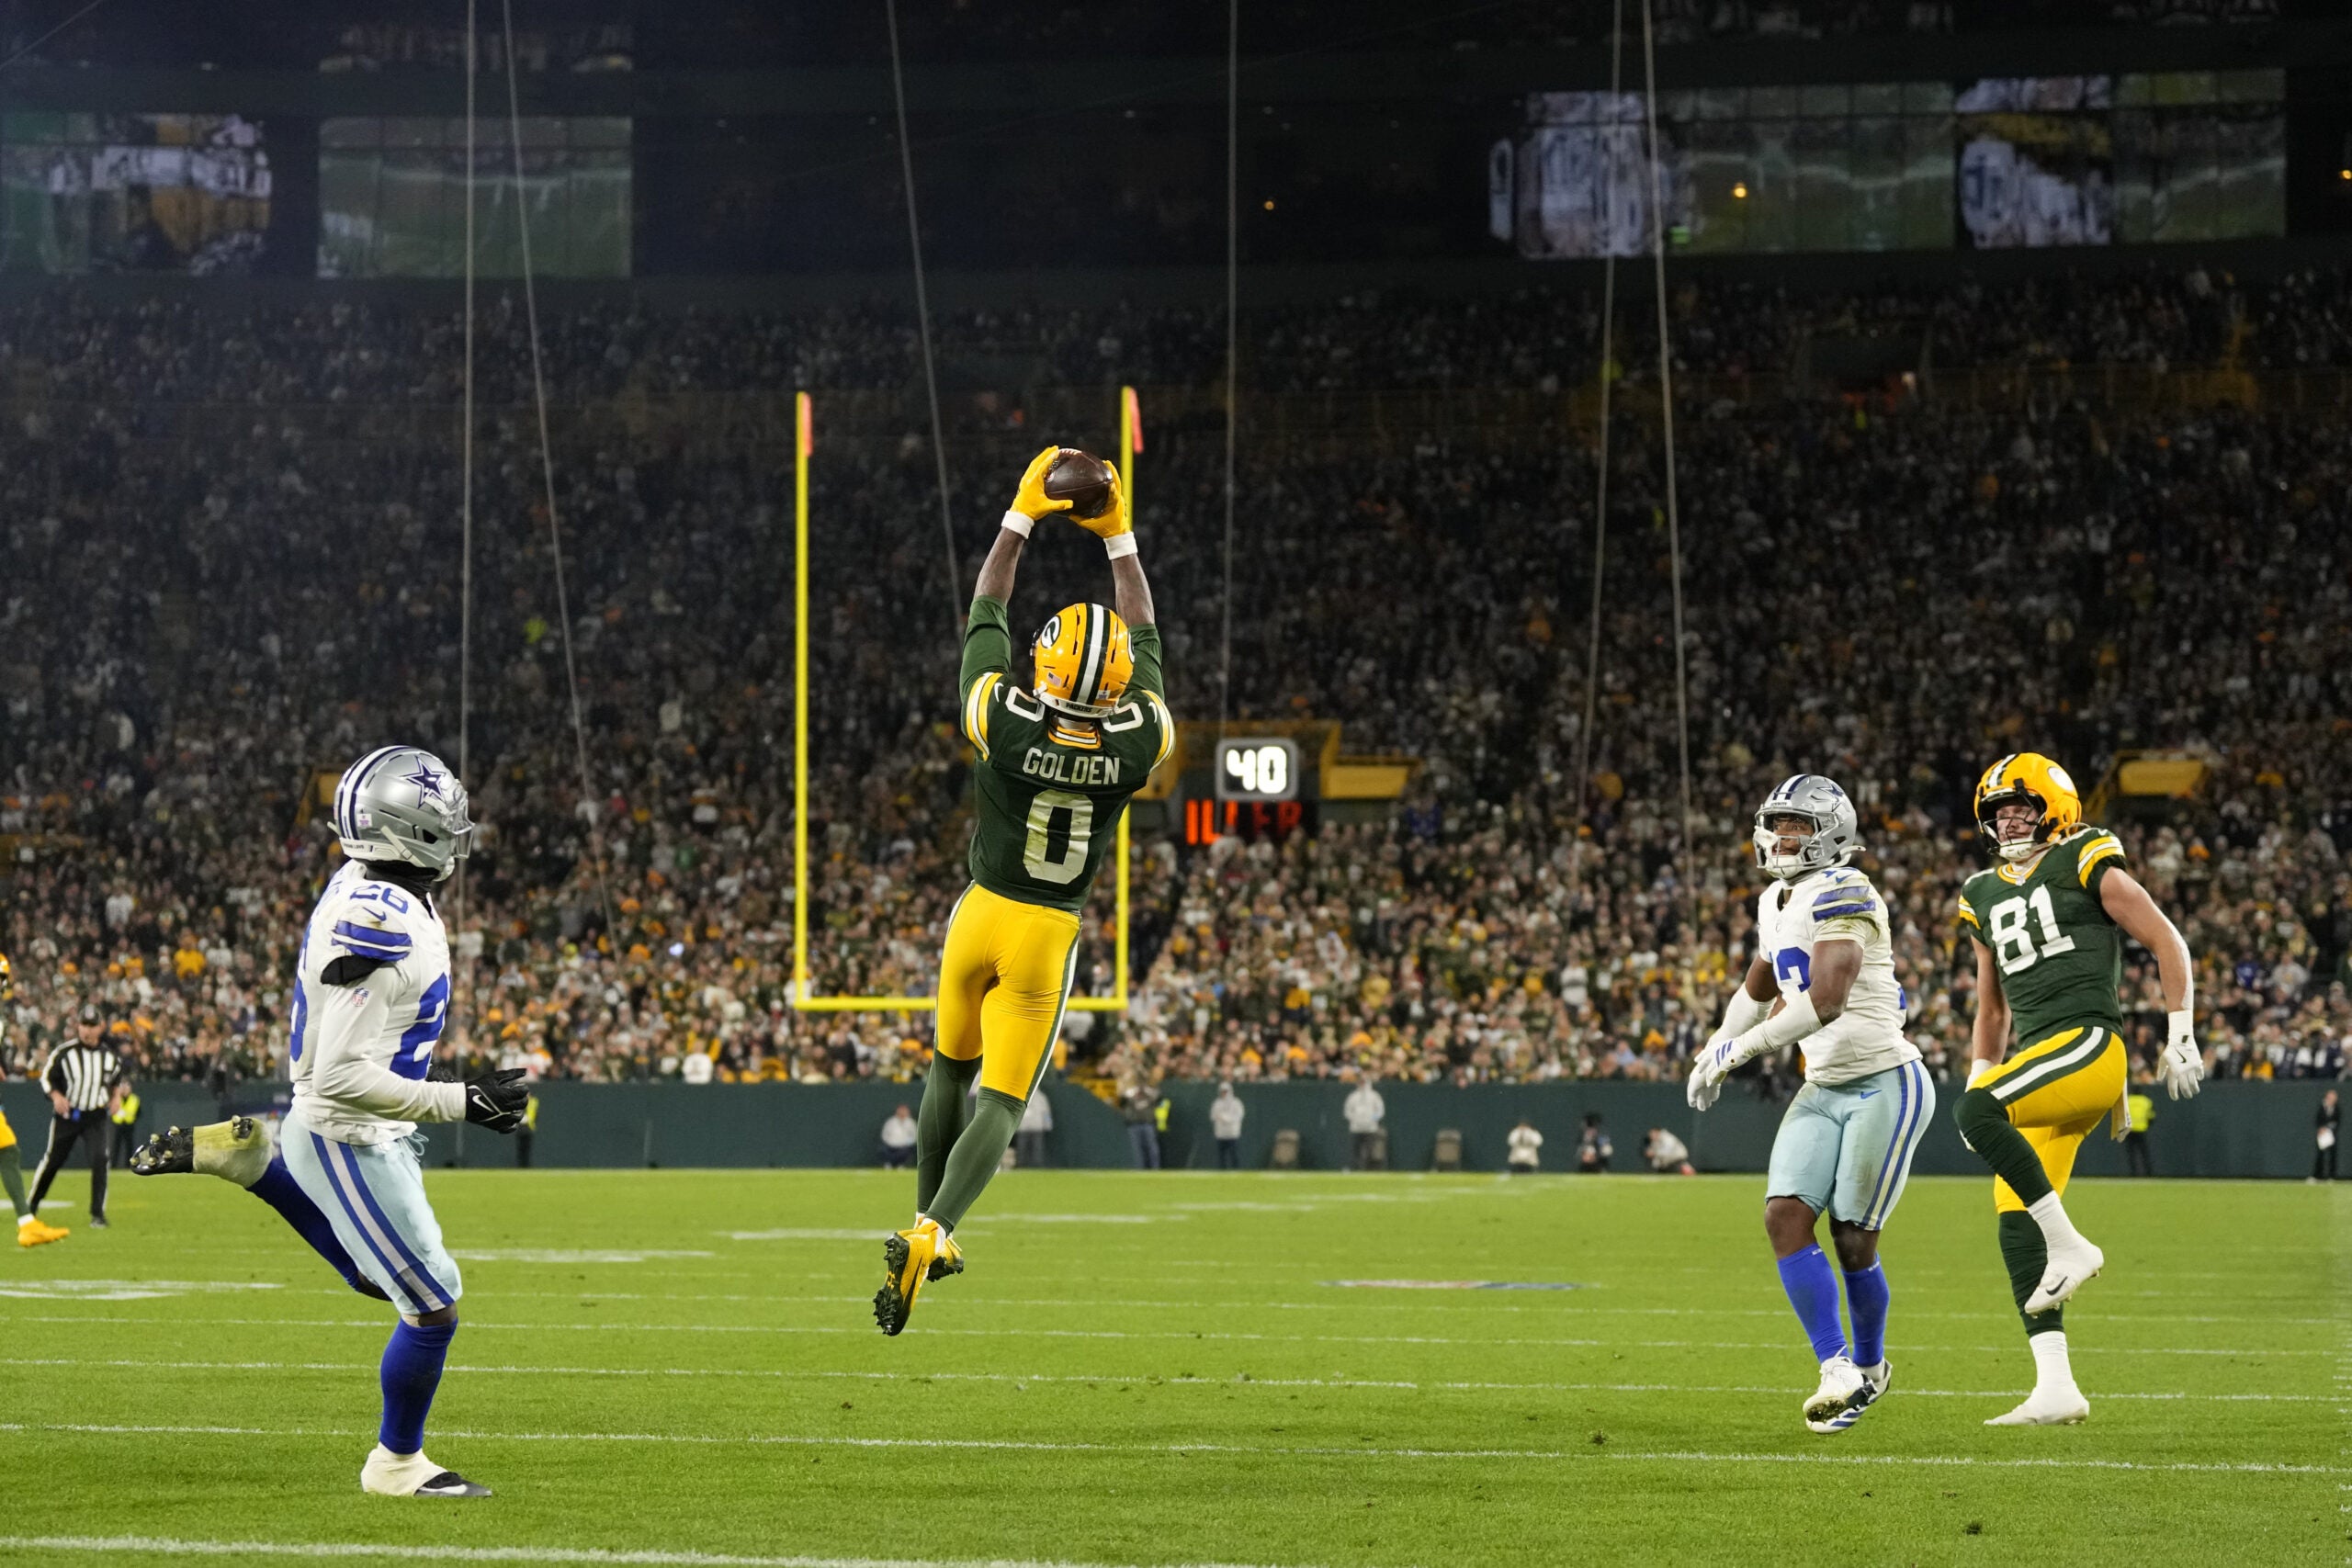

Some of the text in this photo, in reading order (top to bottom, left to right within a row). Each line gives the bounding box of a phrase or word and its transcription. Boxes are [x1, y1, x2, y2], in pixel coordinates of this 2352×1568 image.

[1066, 702, 1092, 713] PACKERS
[1023, 747, 1120, 784] GOLDEN
[1227, 746, 1286, 794] 40
[1023, 788, 1094, 885] 0
[350, 884, 409, 914] 26
[1989, 884, 2076, 976] 81
